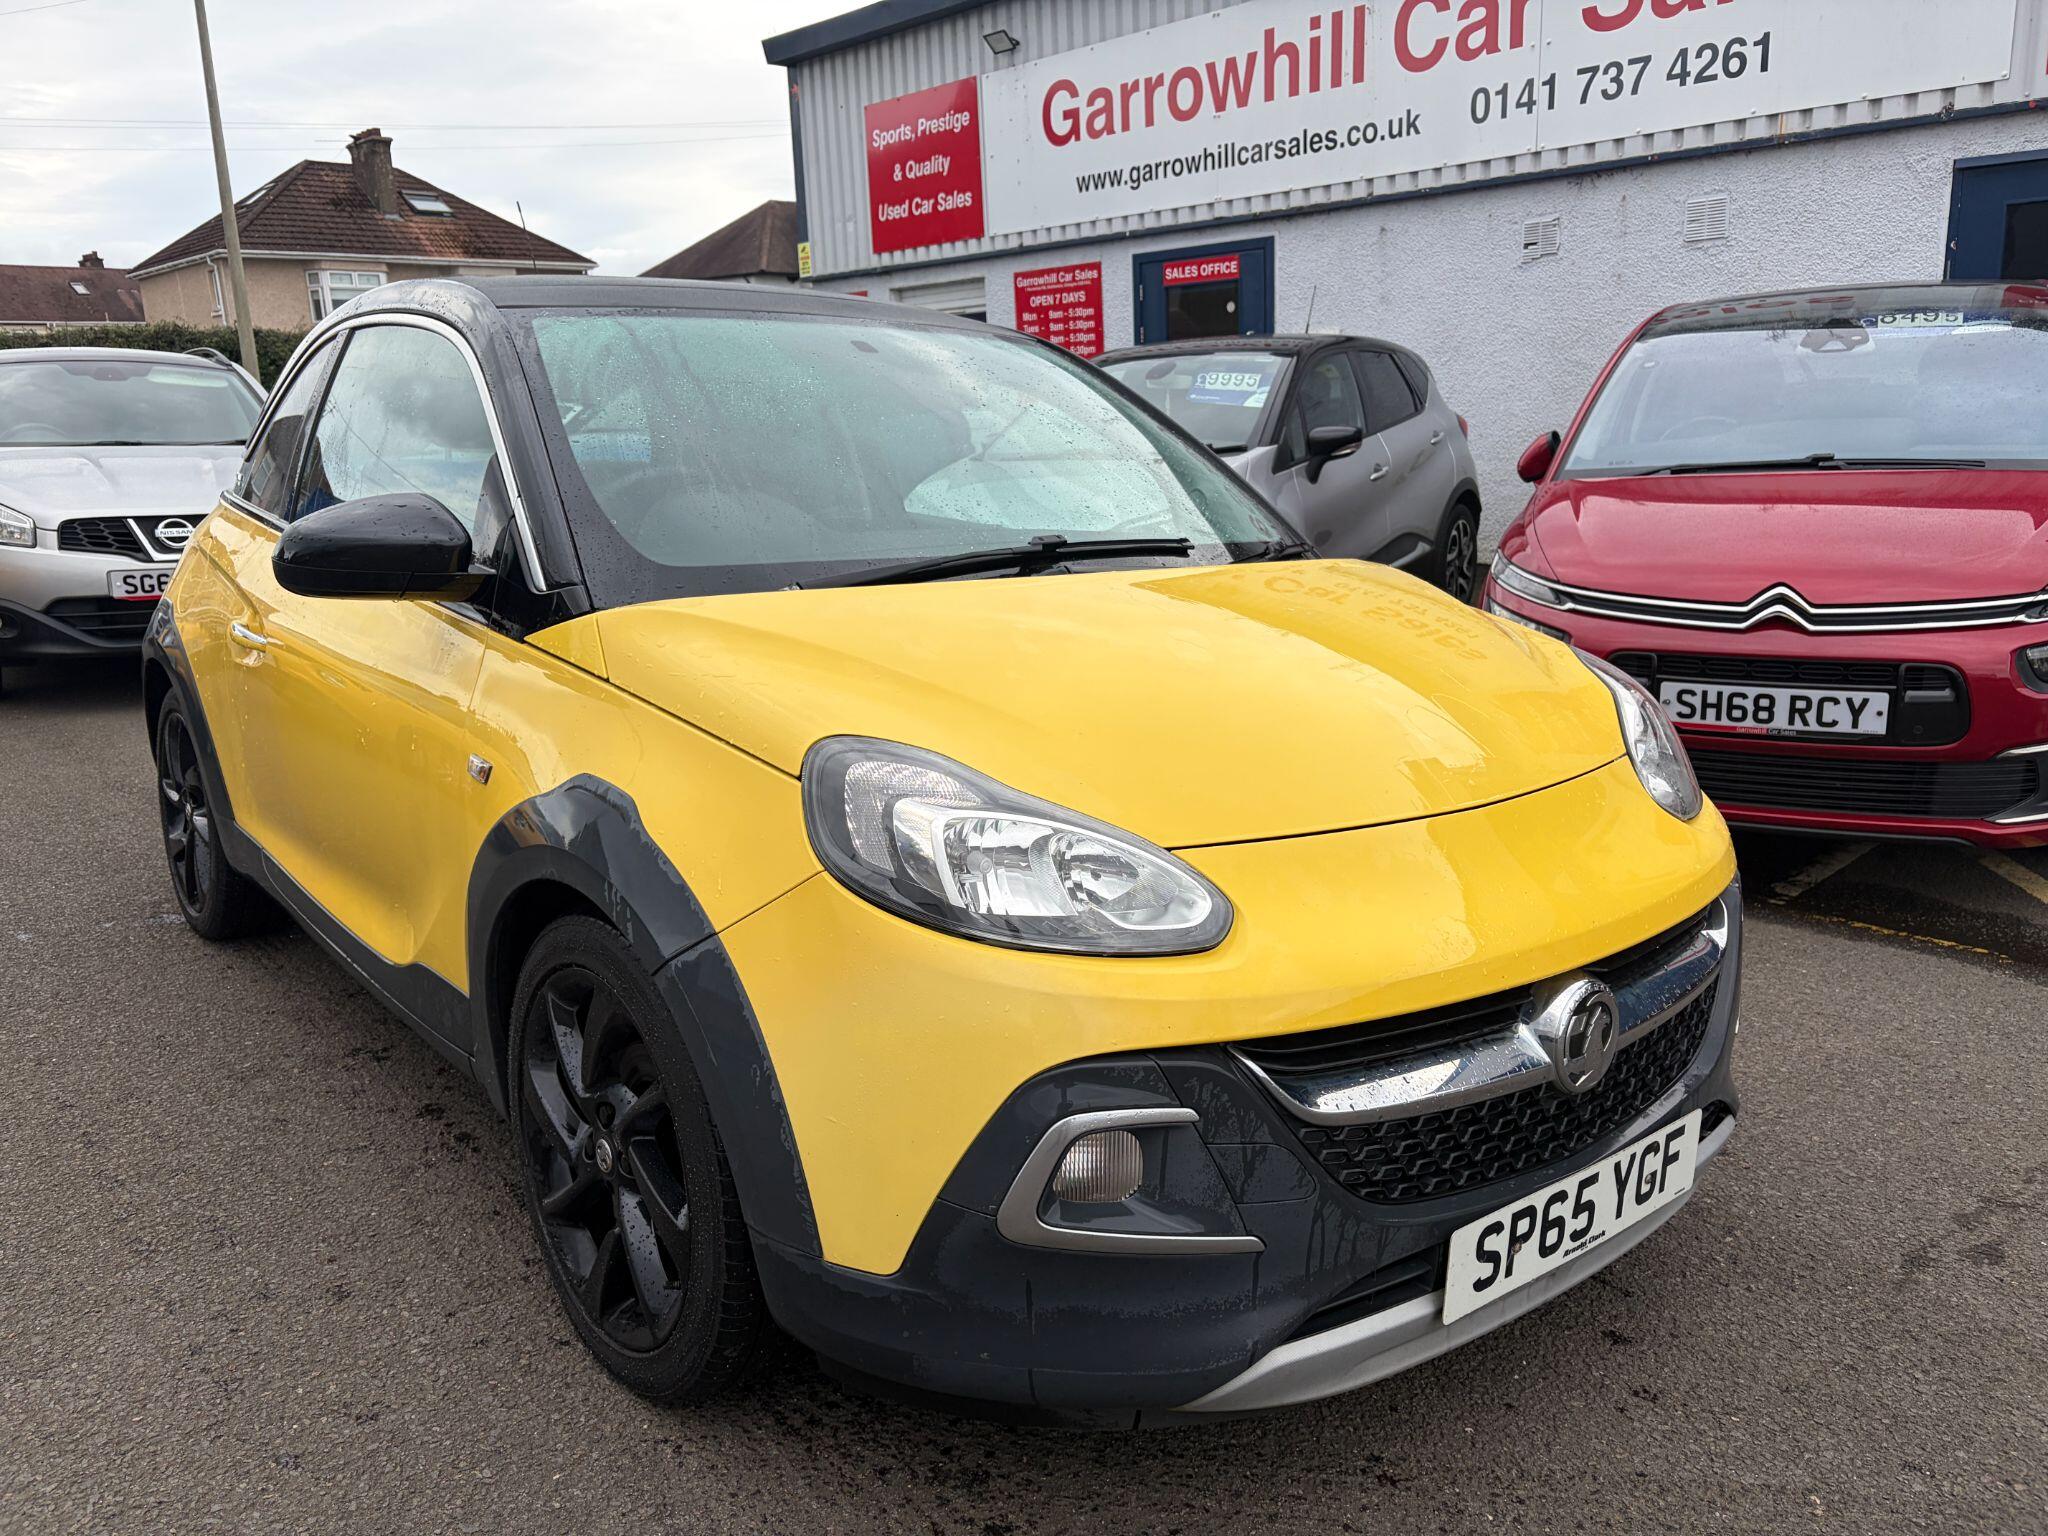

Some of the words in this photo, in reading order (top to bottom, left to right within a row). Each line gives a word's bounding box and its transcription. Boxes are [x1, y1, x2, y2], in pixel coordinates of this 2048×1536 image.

[1042, 4, 1366, 147] Garrowhill
[1393, 0, 1530, 73] Car
[1470, 73, 1557, 125] 0141
[1577, 54, 1653, 106] 737
[1666, 31, 1772, 88] 4261
[872, 124, 915, 150] Sports,
[917, 110, 970, 133] Prestige
[1076, 108, 1422, 194] www.garrowhillcarsales.co.uk
[893, 163, 902, 182] &
[905, 155, 951, 180] Quality
[878, 200, 909, 222] Used
[911, 197, 935, 216] Car
[937, 190, 972, 212] Sales
[1016, 273, 1057, 288] Garrowhill
[1058, 272, 1073, 283] Car
[1074, 269, 1098, 281] Sales
[1165, 265, 1198, 280] SALES
[1200, 261, 1238, 277] OFFICE
[1030, 294, 1054, 307] OPEN
[1055, 293, 1060, 304] 7
[1062, 291, 1086, 303] DAYS
[1022, 312, 1037, 321] Mon
[1068, 308, 1094, 318] 5:30pm
[1069, 320, 1095, 331] 5:30pm
[1676, 689, 1776, 724] SH68
[1788, 695, 1870, 730] RCY
[1473, 1171, 1600, 1293] SP65
[1614, 1123, 1687, 1220] YGF
[1563, 1239, 1588, 1258] Arnold
